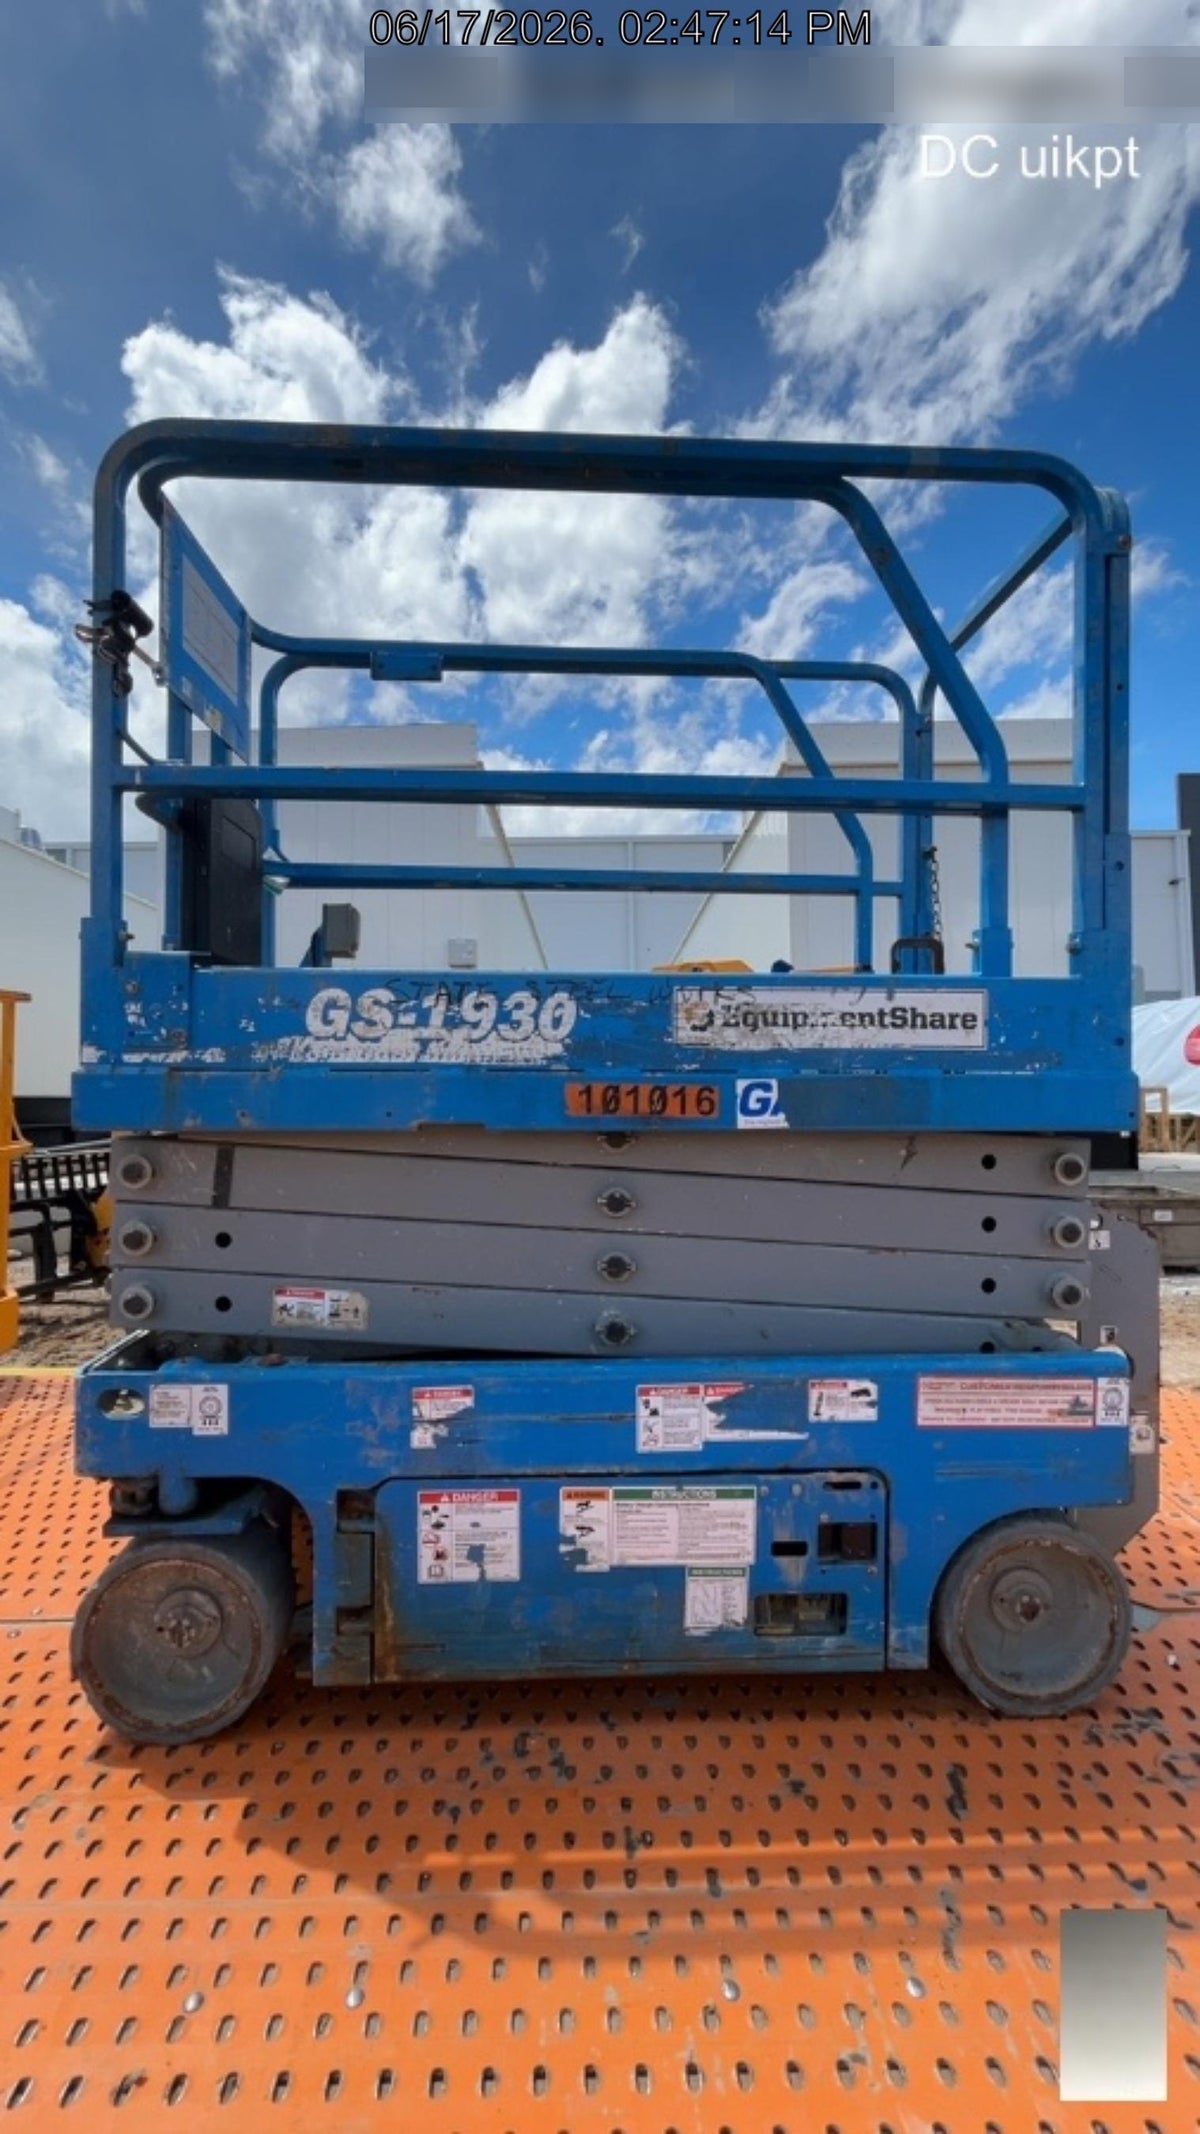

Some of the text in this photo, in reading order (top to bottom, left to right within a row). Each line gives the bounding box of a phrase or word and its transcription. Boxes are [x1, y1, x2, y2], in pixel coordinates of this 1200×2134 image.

[305, 987, 577, 1042] GS-1930
[720, 1006, 978, 1032] EquipentShare
[578, 1084, 716, 1115] 101016
